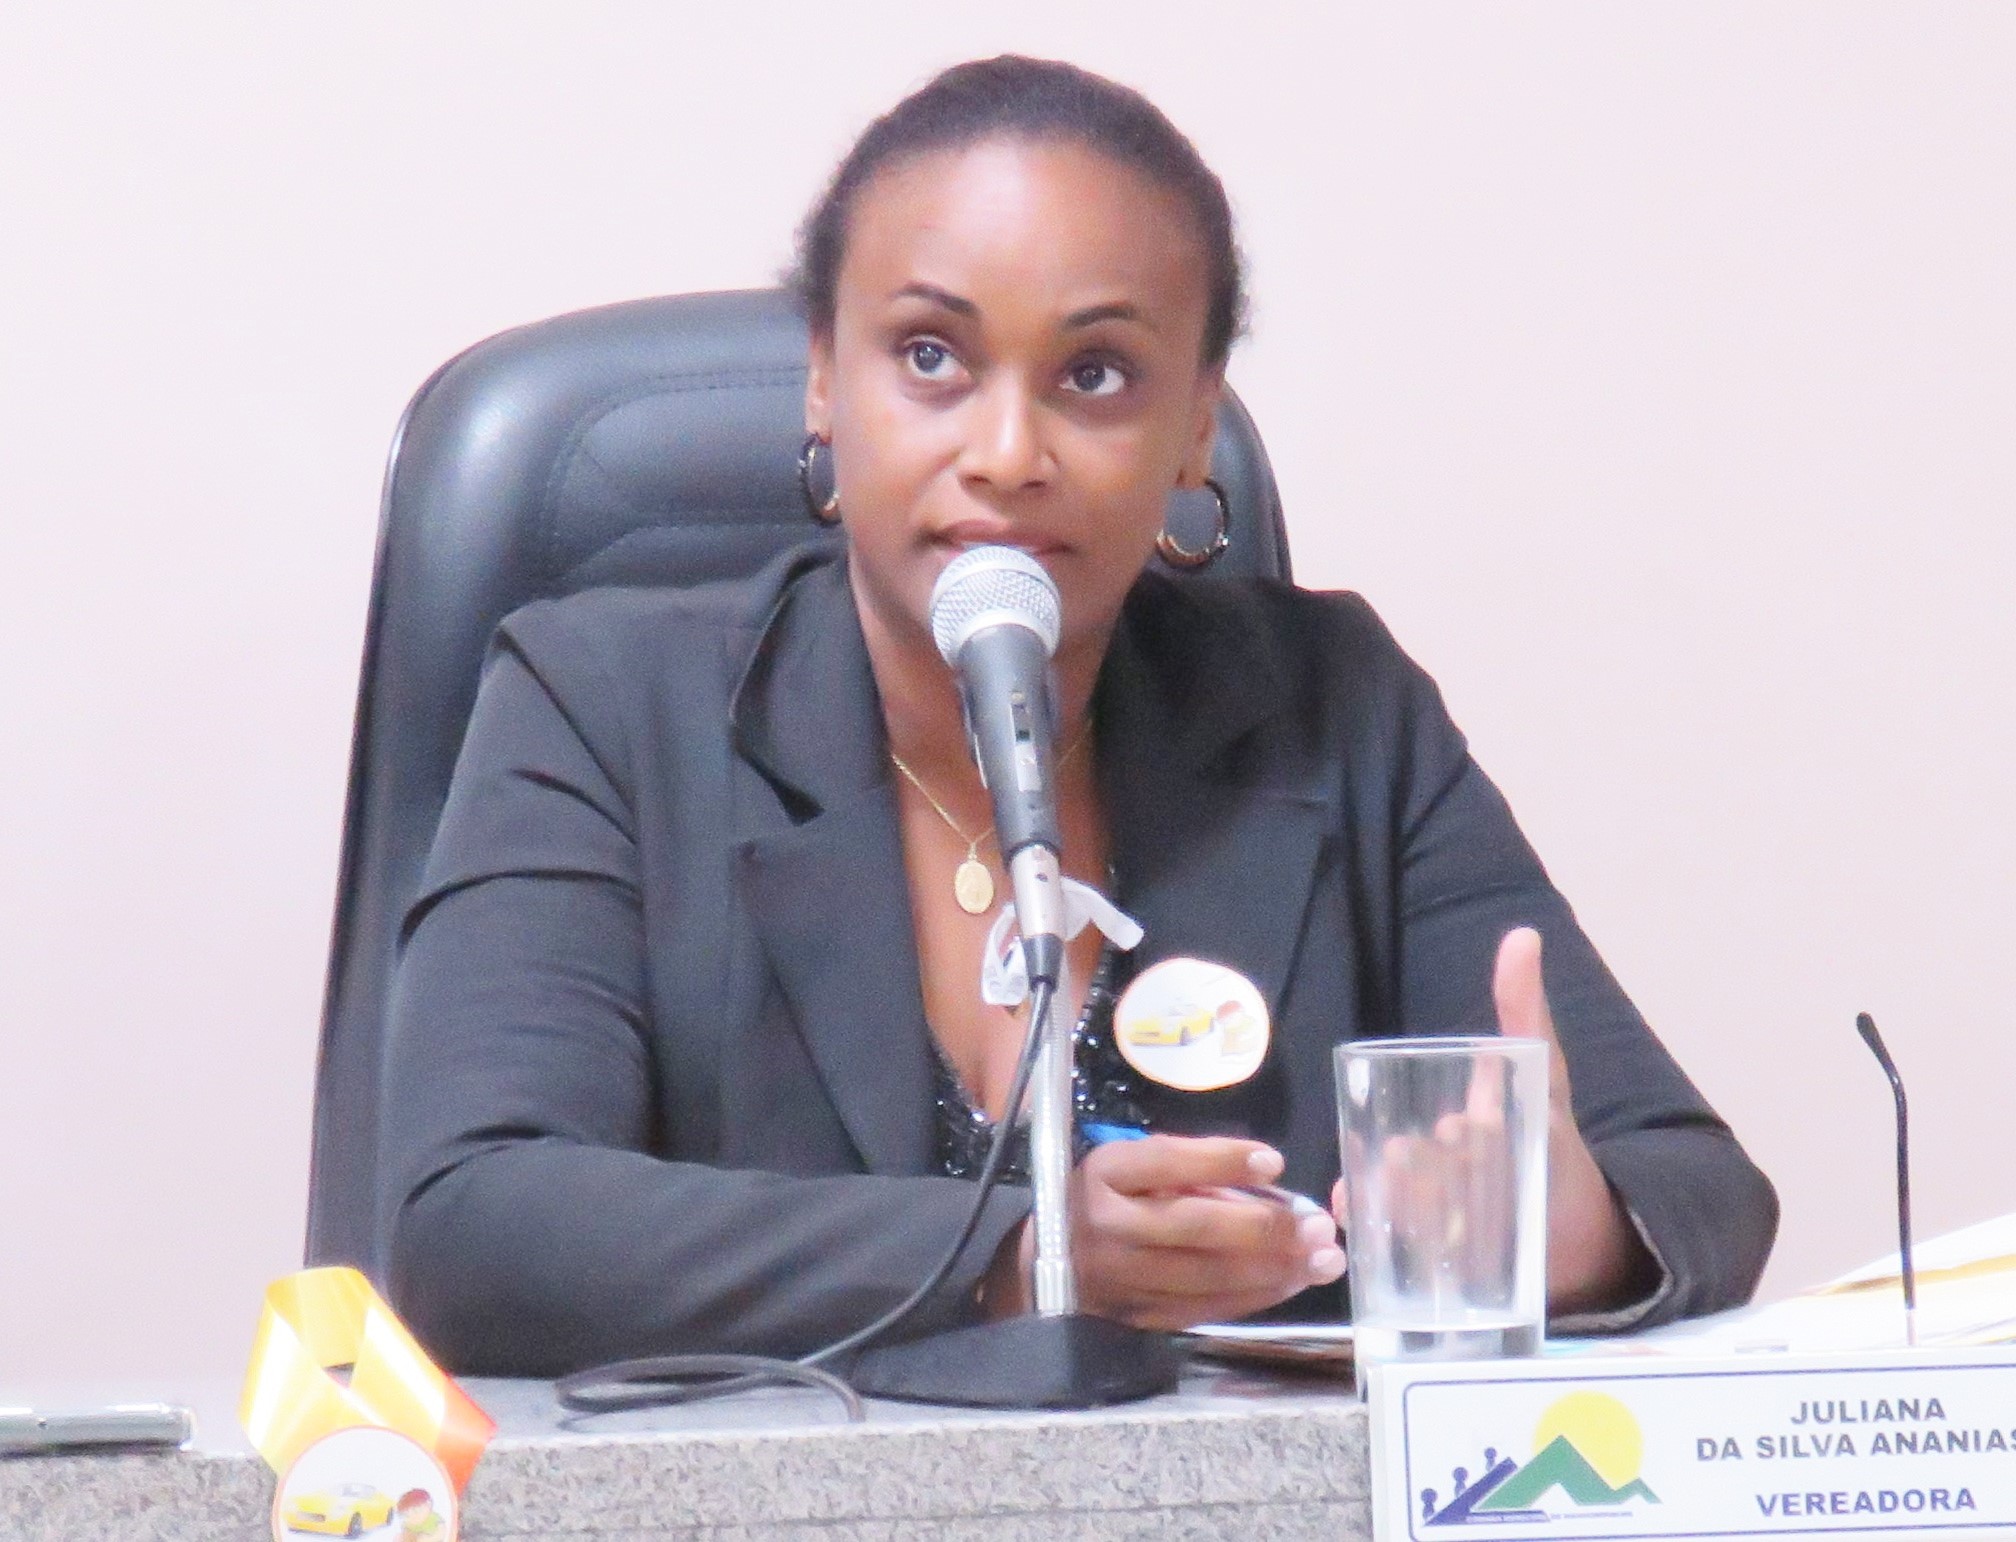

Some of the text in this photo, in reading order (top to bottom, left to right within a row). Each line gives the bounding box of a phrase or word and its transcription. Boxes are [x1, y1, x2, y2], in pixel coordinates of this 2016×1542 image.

[1790, 1398, 1946, 1425] JULIANA
[1696, 1437, 1743, 1462] DA
[1755, 1433, 1857, 1460] SILVA
[1755, 1487, 1977, 1517] VEREADORA
